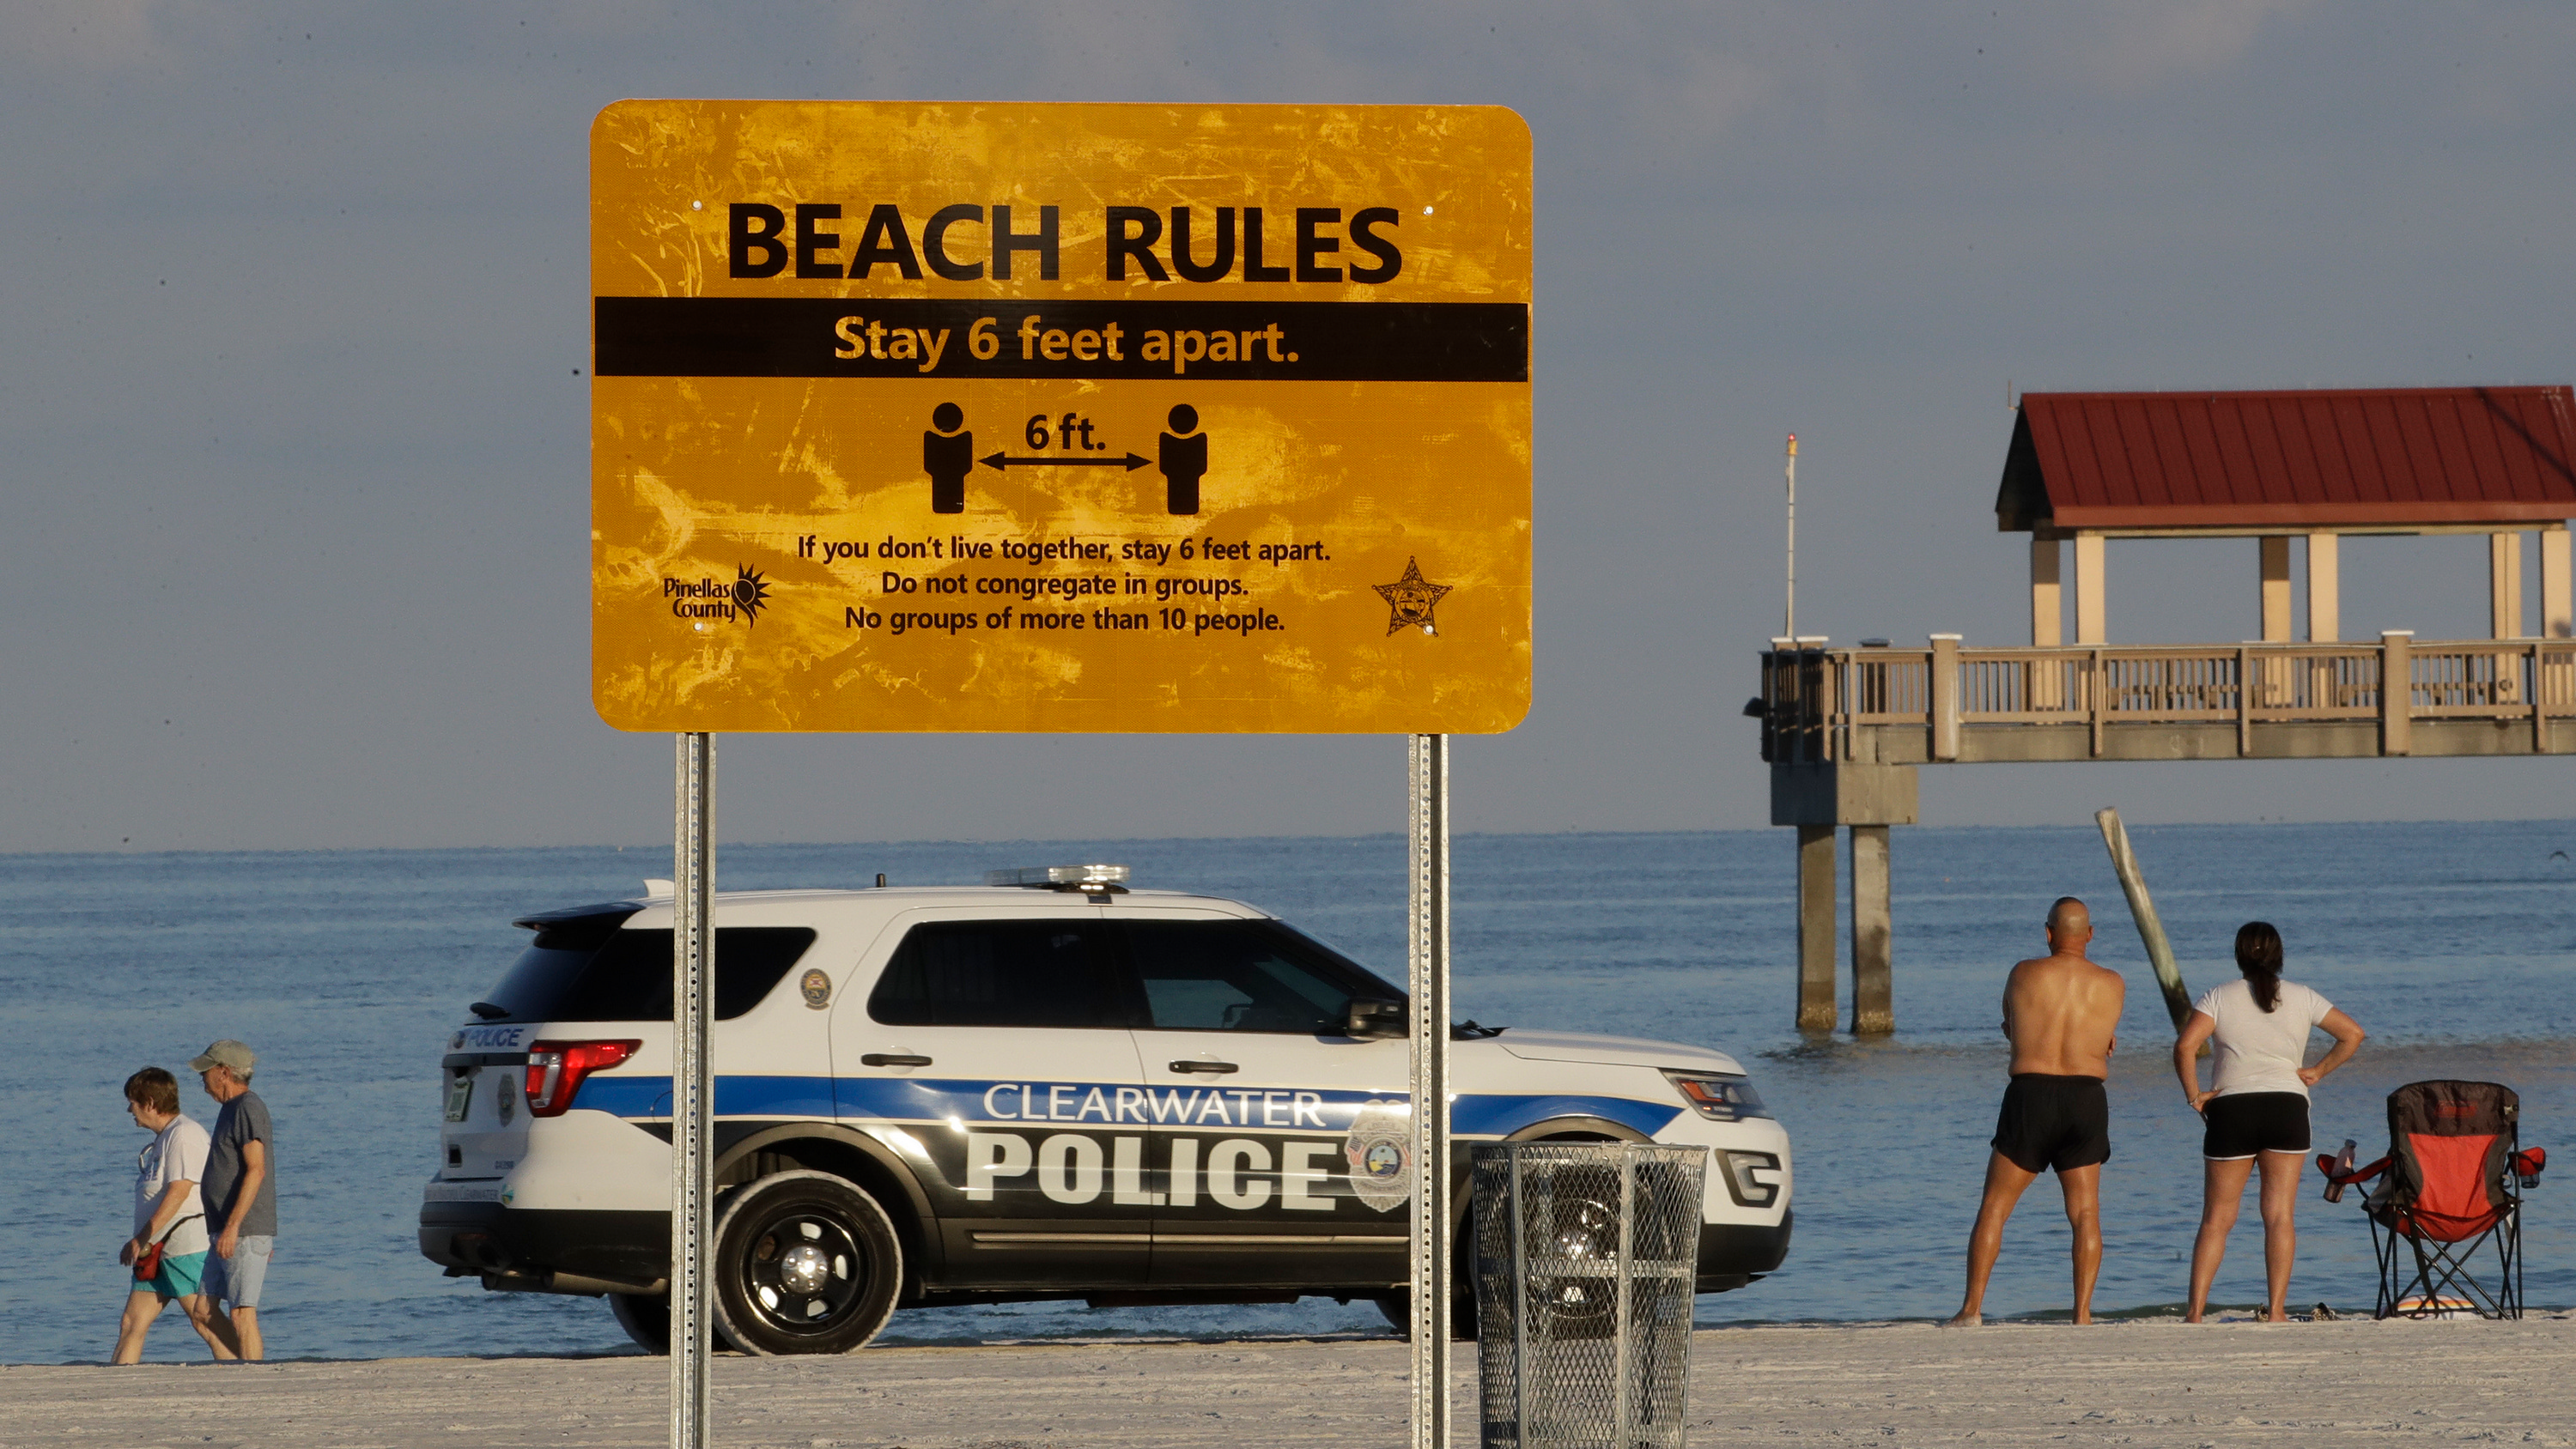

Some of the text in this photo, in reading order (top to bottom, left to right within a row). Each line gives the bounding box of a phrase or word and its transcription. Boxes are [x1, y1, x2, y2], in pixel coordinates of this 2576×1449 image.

[731, 204, 1402, 284] BEACH RULES
[836, 315, 1299, 374] Stay 6 feet apart.
[1026, 414, 1106, 452] 6 ft.
[799, 536, 1331, 567] If you don’t live together, stay 6 feet apart.
[664, 577, 731, 598] Pinellas
[883, 573, 1249, 602] Do not congregate in groups.
[672, 597, 737, 624] County
[846, 606, 1285, 636] No groups of more than 10 people.
[468, 1028, 525, 1047] POLICE
[983, 1083, 1327, 1127] CLEARWATER
[967, 1133, 1338, 1211] POLICE
